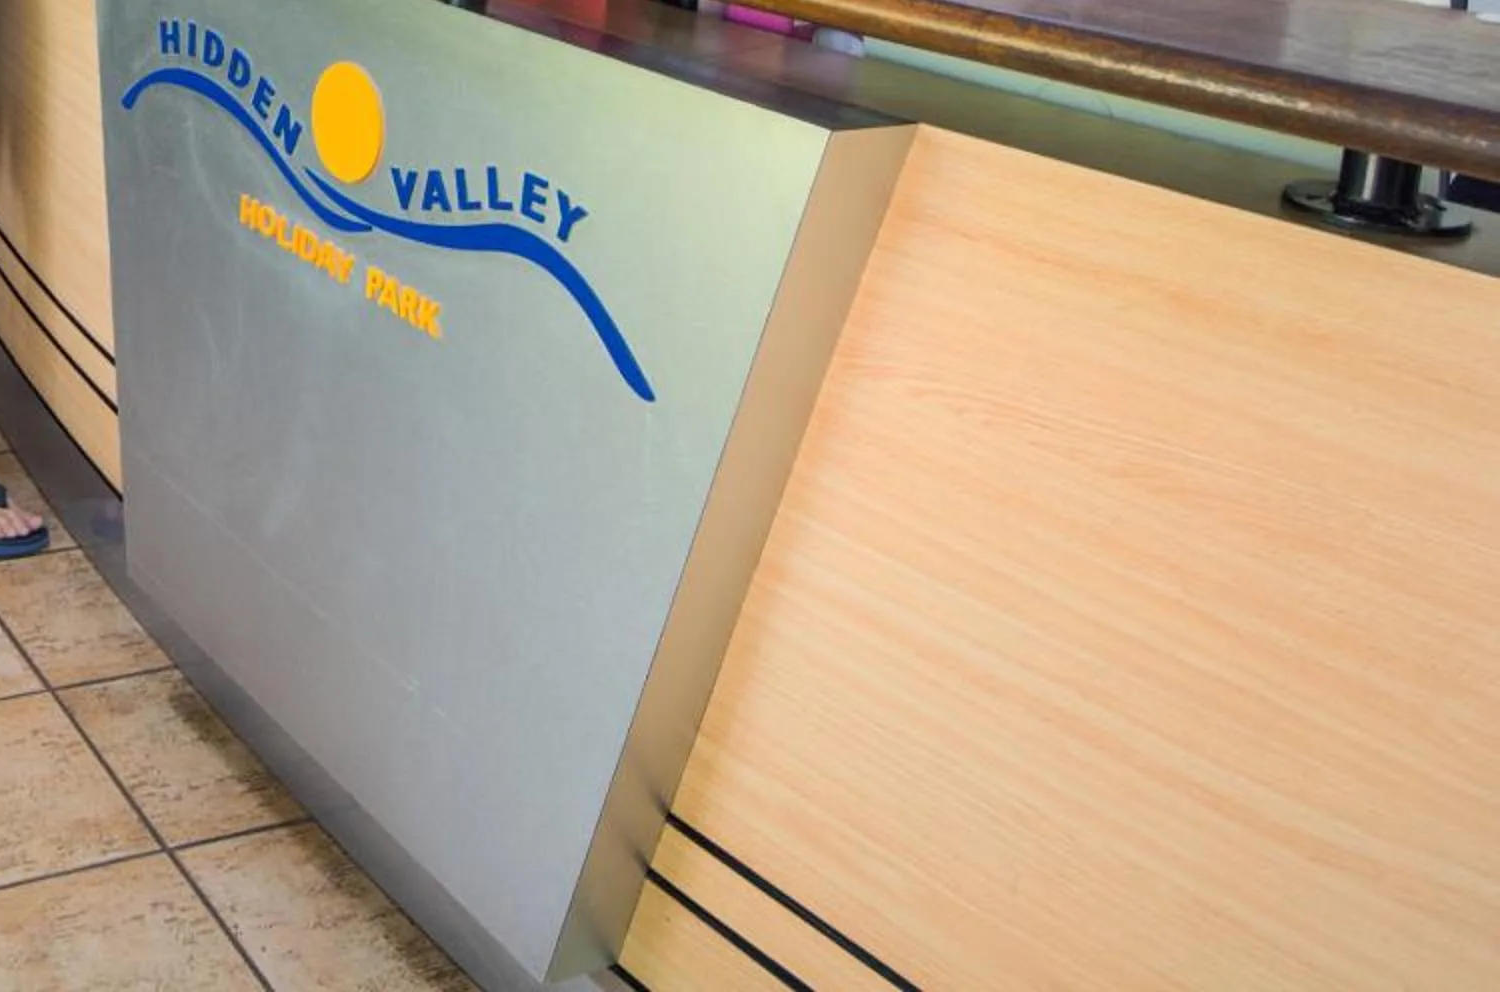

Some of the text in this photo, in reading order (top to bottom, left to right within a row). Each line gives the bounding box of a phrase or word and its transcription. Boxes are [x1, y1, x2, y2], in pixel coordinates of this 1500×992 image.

[159, 20, 589, 243] HIDDEN VALLEY
[238, 194, 443, 340] HOLIDAY PARK
